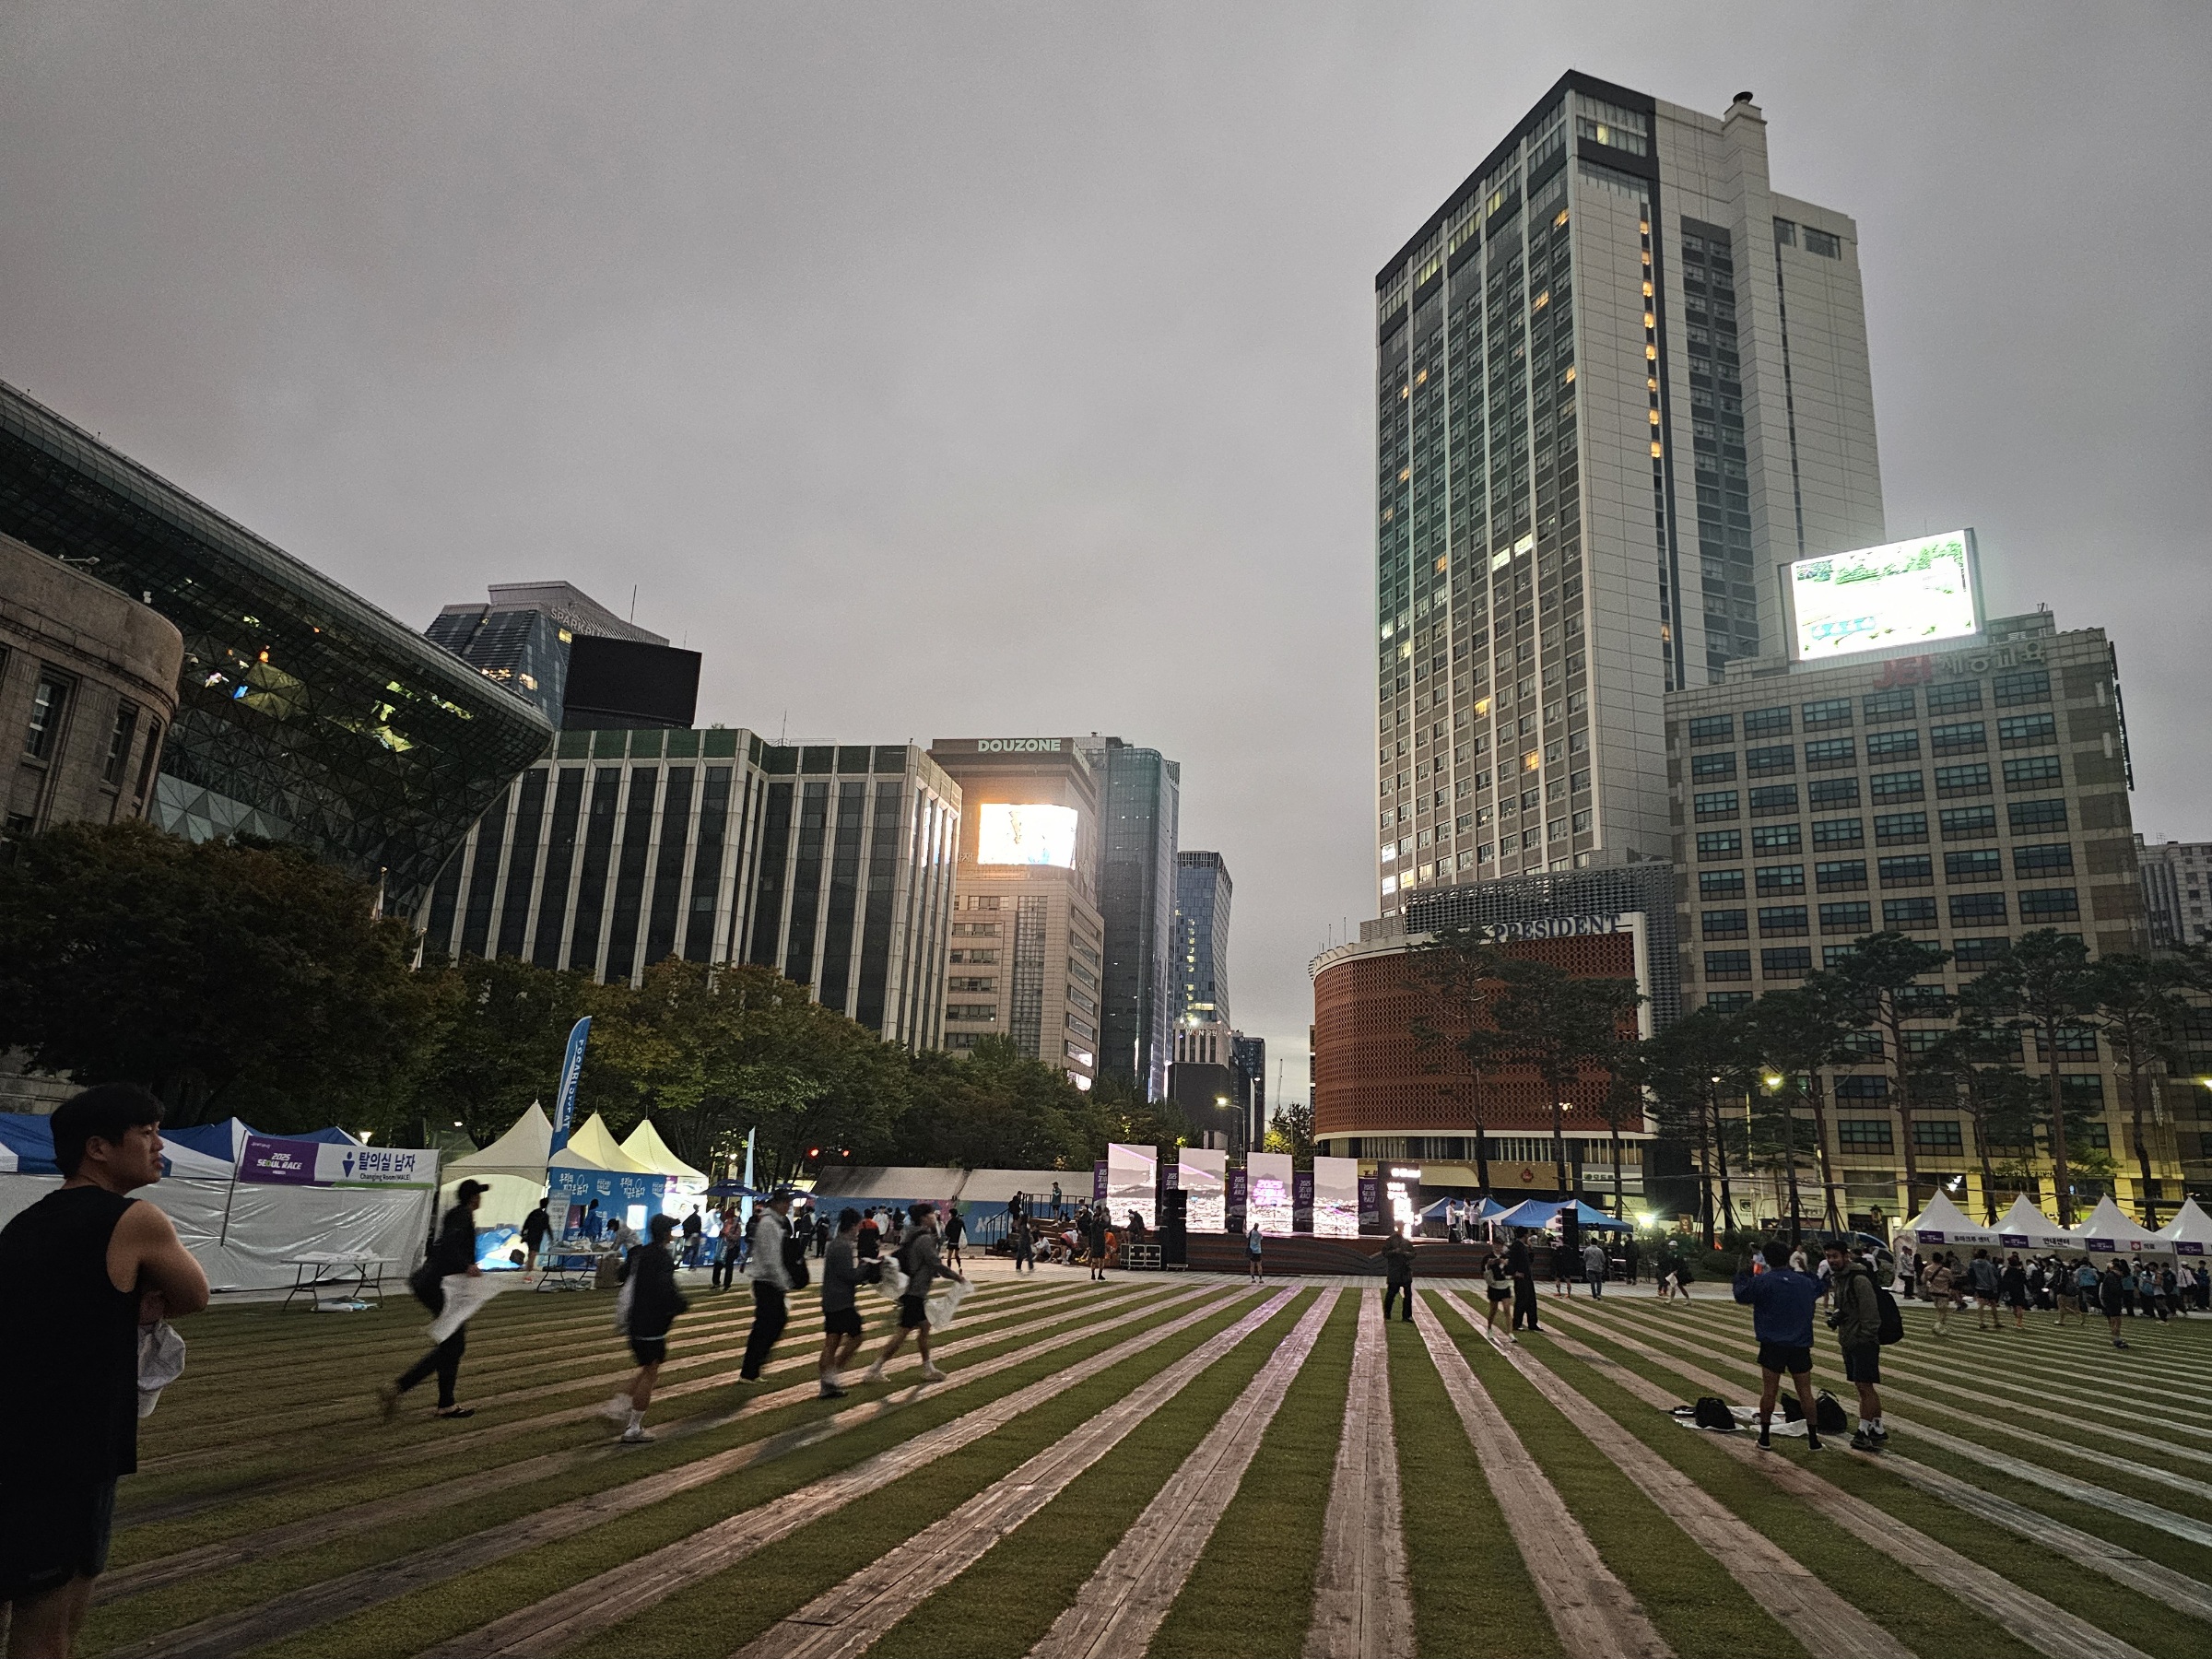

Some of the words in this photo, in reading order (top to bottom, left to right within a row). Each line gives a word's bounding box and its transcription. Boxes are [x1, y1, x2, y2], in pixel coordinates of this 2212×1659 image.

[1873, 654, 1933, 689] JEI
[1940, 642, 2046, 675] 재능교육
[978, 738, 1061, 753] DOUZONE
[1493, 913, 1620, 944] PRESIDENT
[271, 1152, 292, 1161] 2025
[359, 1151, 392, 1171] 탈의실
[394, 1153, 416, 1172] 남자
[256, 1159, 281, 1169] SEOUL
[281, 1161, 303, 1171] RACE
[359, 1172, 382, 1182] Changing
[559, 1172, 574, 1184] 우리의
[619, 1176, 633, 1187] 우리의
[1255, 1179, 1283, 1189] 2025
[2042, 1237, 2071, 1246] 안내센터
